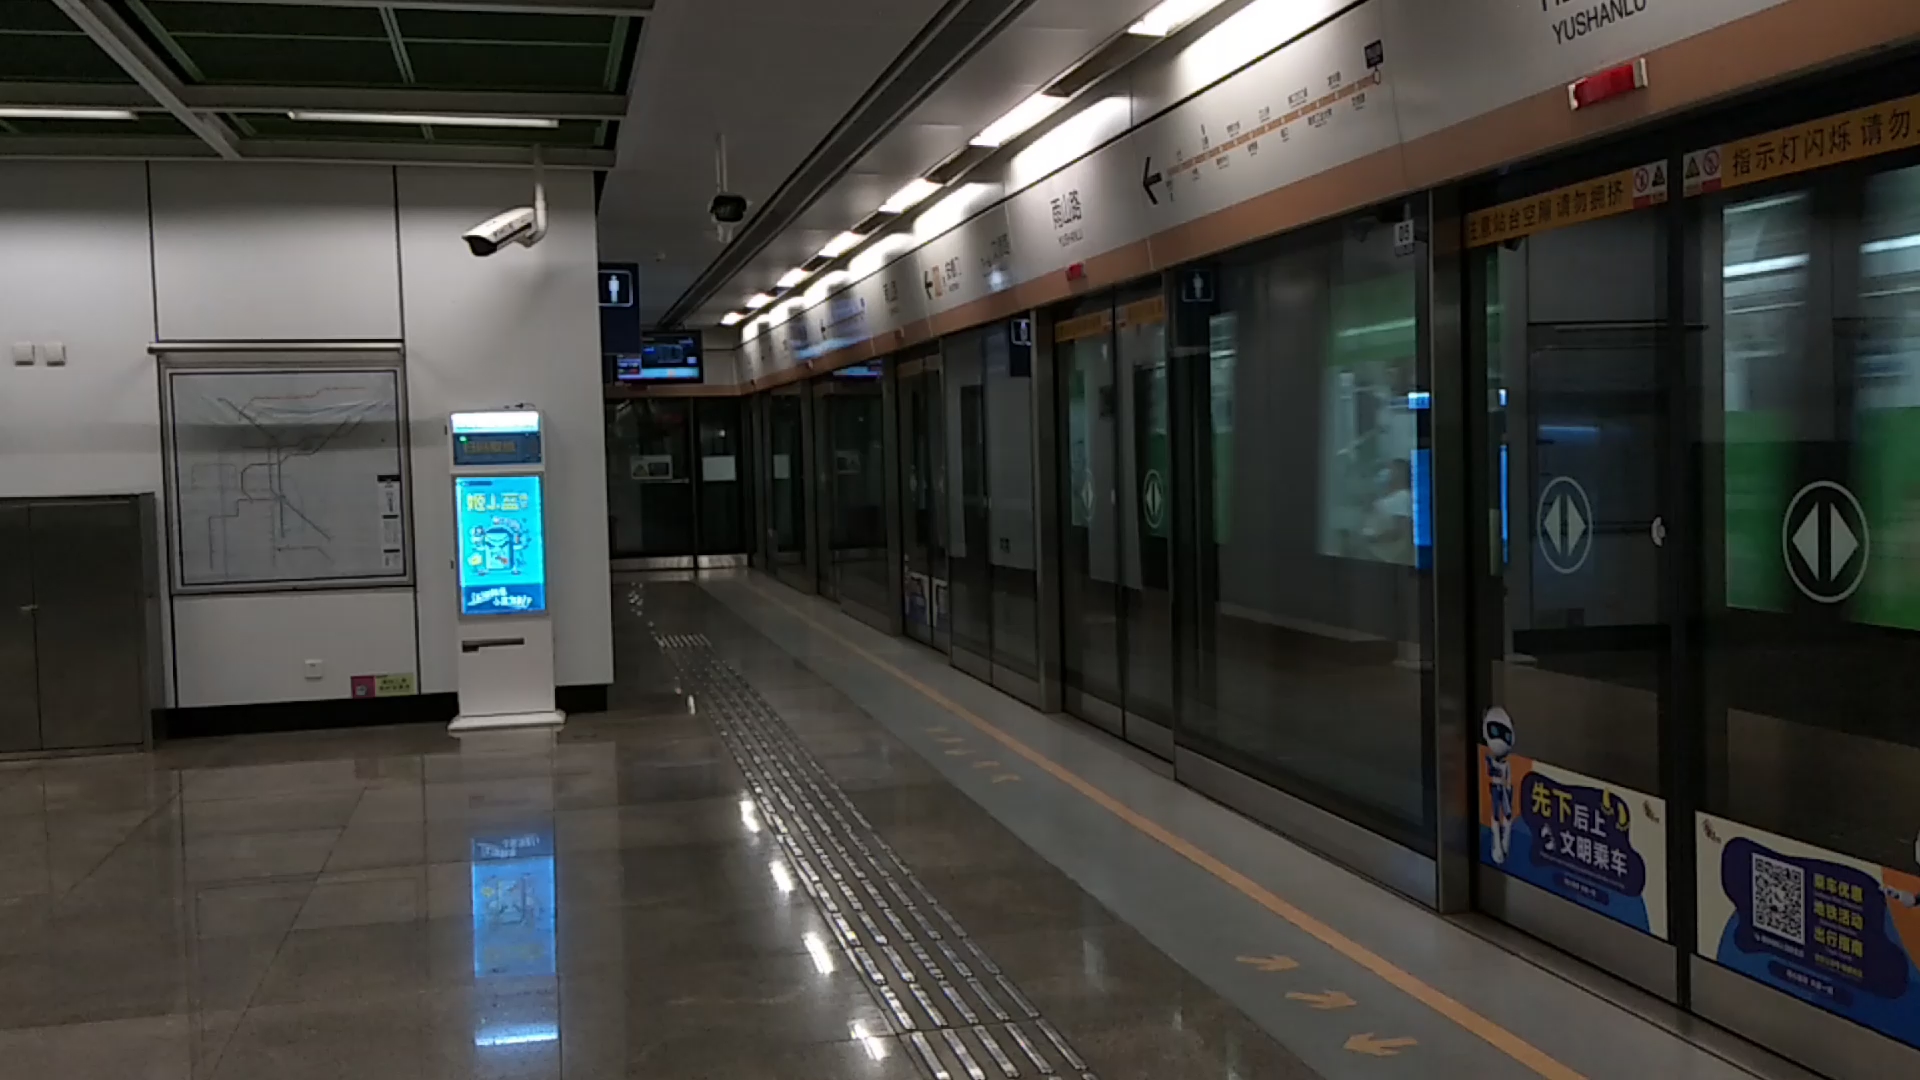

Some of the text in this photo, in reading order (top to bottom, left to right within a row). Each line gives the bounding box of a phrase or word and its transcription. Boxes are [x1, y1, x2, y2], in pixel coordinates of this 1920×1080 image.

[1733, 108, 1920, 177] 指示灯闪烁 请勿
[1531, 781, 1608, 838] 先下后上
[1559, 830, 1628, 878] 文明乘车
[1813, 899, 1864, 931] 地铁活动
